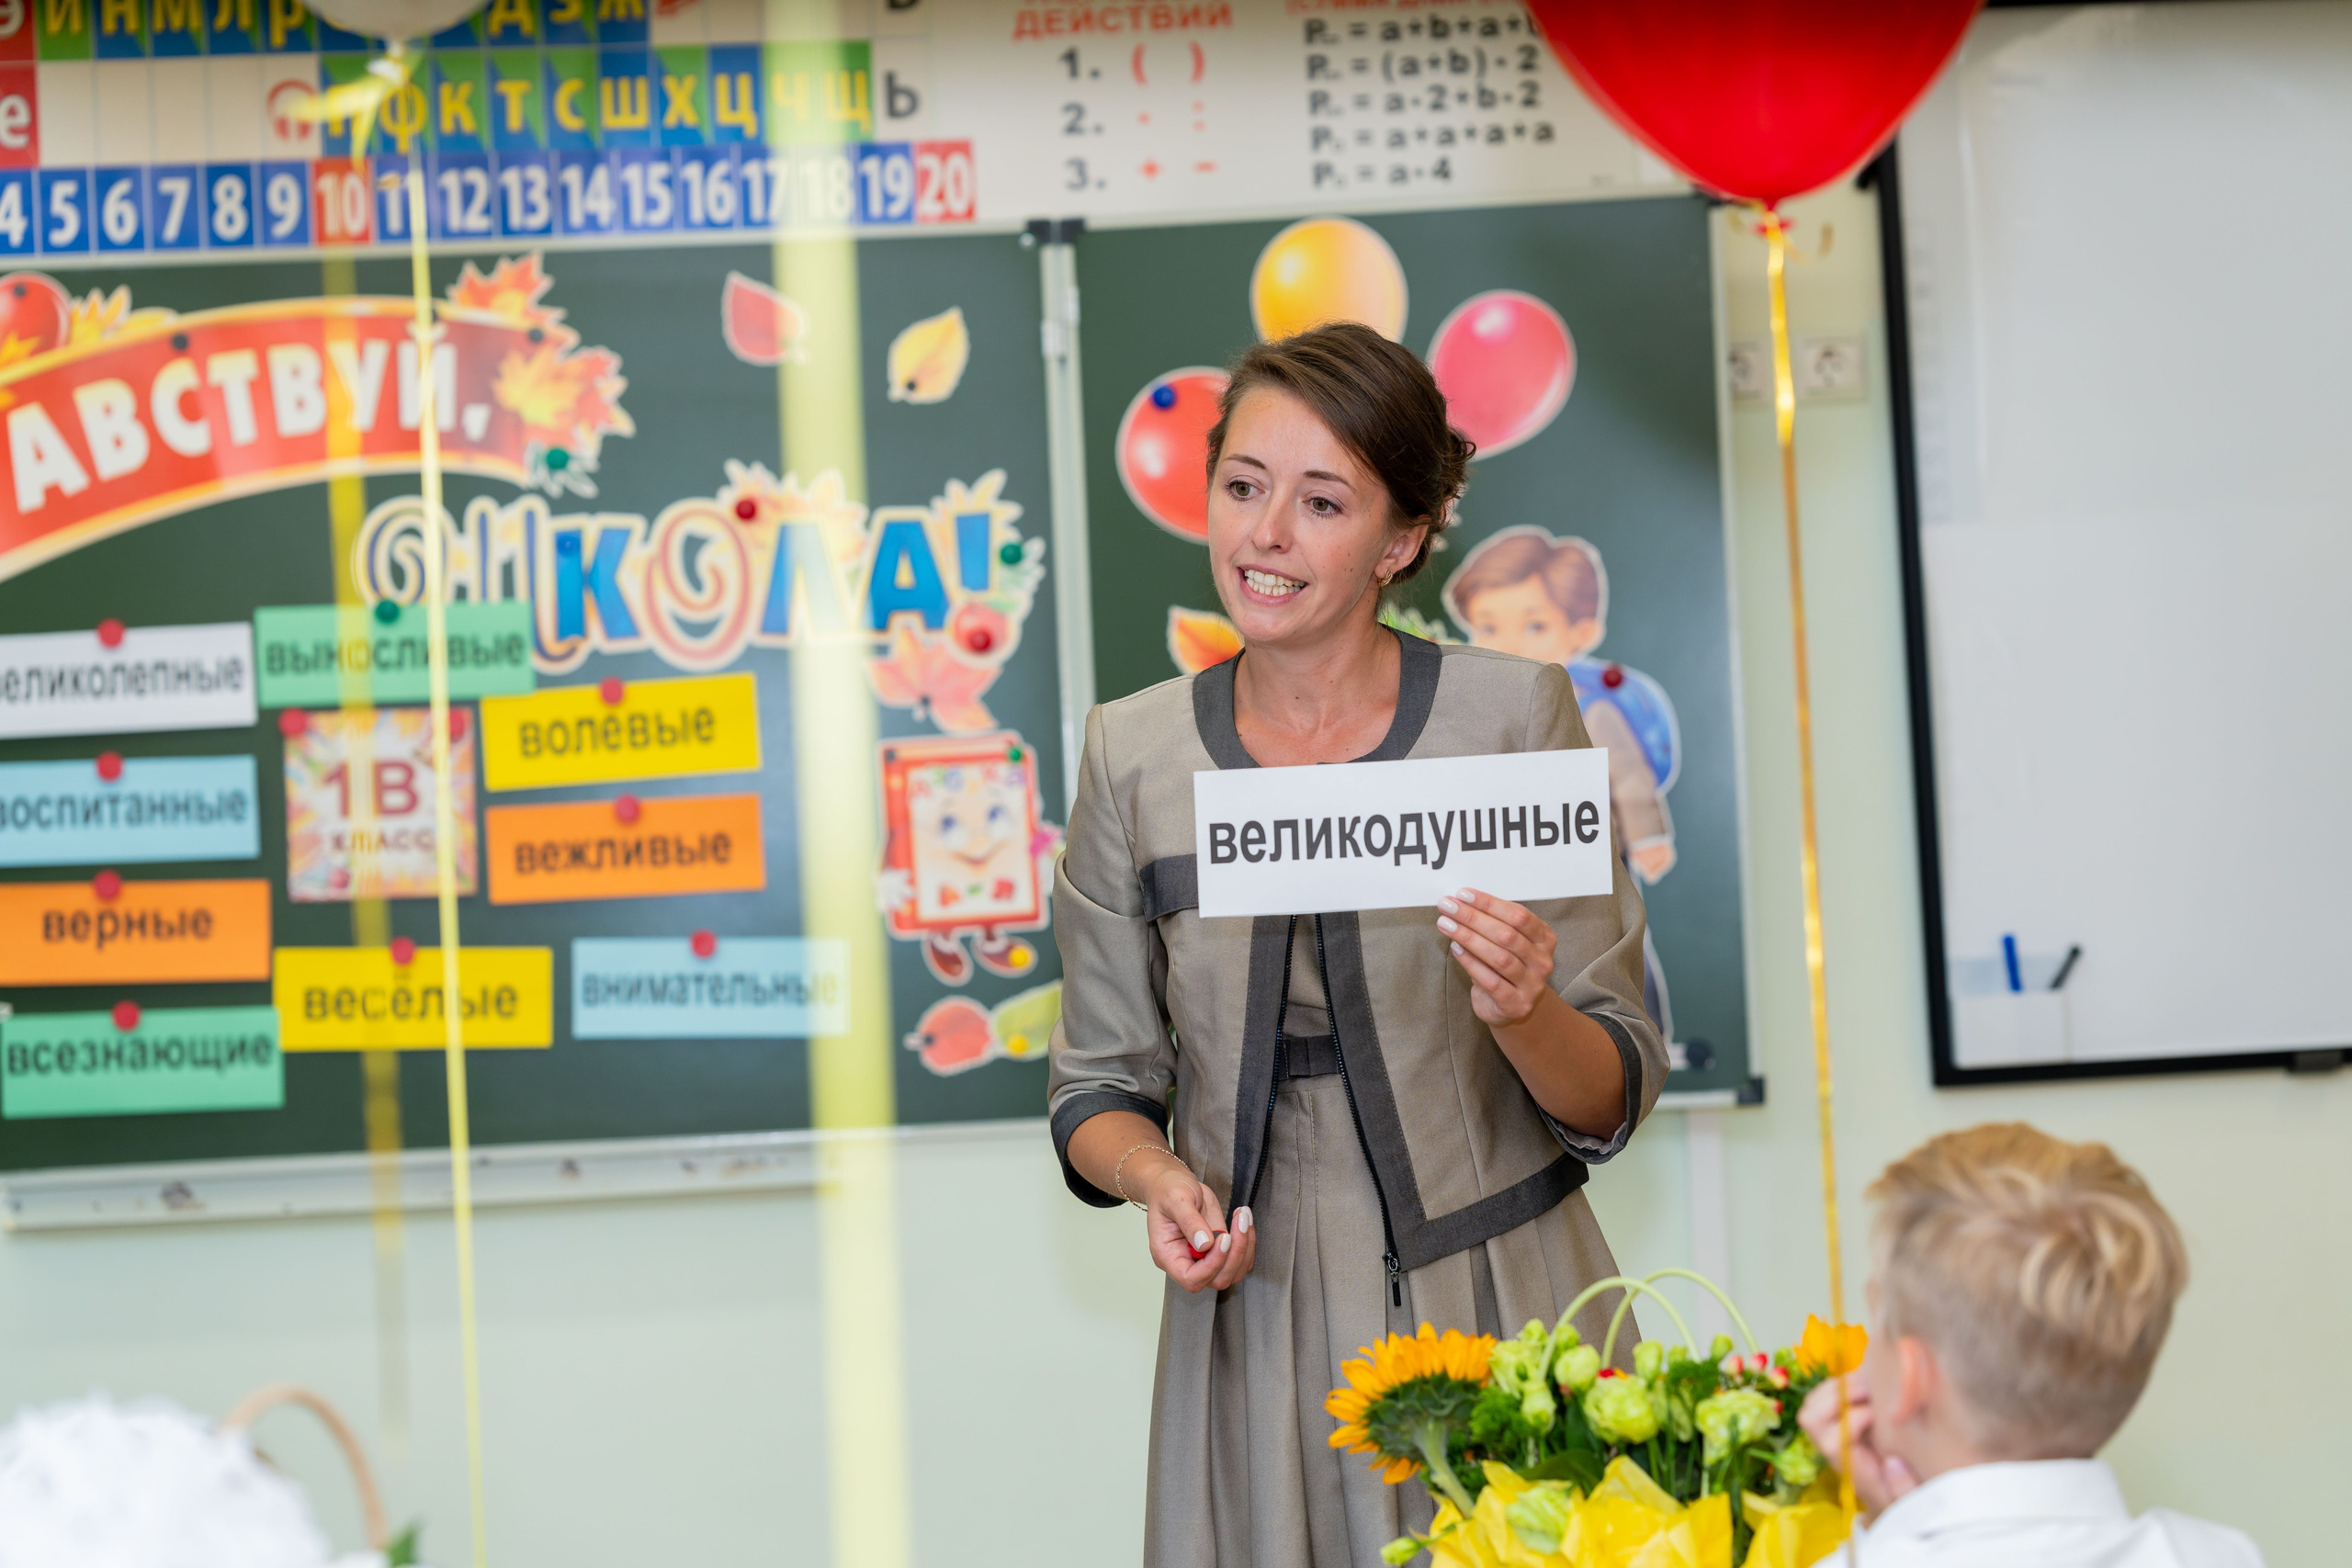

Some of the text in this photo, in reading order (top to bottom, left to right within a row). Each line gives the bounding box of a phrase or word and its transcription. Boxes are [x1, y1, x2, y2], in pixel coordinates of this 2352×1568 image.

[438, 81, 478, 134] к
[495, 80, 532, 133] т
[600, 76, 649, 130] ш
[715, 73, 758, 138] ц
[0, 182, 28, 249] 4
[49, 181, 82, 248] 5
[103, 178, 139, 246] 6
[157, 176, 191, 243] 7
[212, 174, 250, 242] 8
[266, 173, 302, 239] 9
[316, 172, 368, 238] 10
[440, 169, 492, 233] 12
[502, 166, 551, 231] 13
[561, 164, 615, 230] 14
[622, 161, 674, 228] 15
[681, 159, 735, 225] 16
[741, 157, 792, 222] 17
[801, 155, 854, 221] 18
[860, 154, 914, 220] 19
[919, 152, 974, 219] 20
[518, 706, 716, 760] волевые
[514, 829, 734, 878] вежливые
[1208, 799, 1600, 871] великодушные
[42, 908, 215, 951] верные
[6, 1032, 273, 1076] всезнающие
